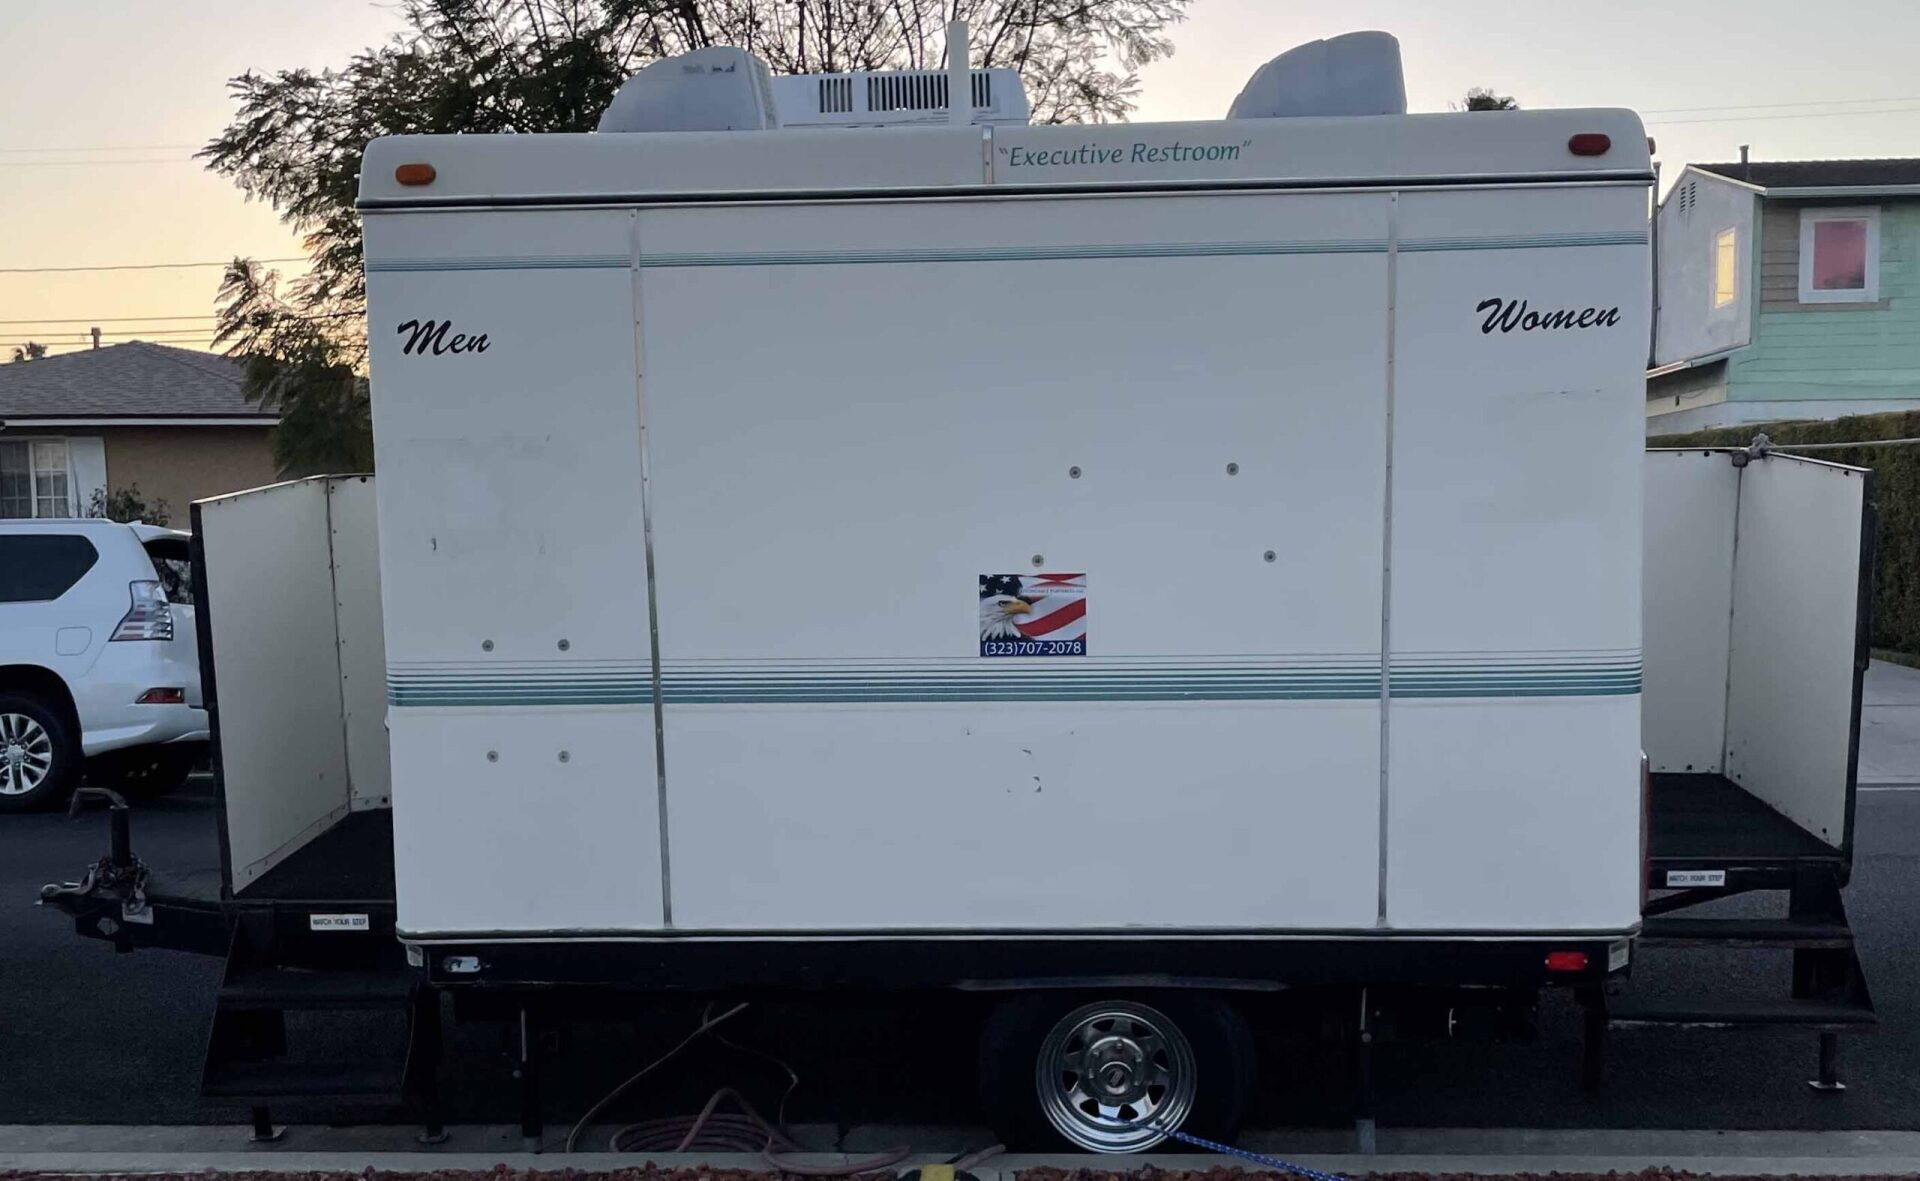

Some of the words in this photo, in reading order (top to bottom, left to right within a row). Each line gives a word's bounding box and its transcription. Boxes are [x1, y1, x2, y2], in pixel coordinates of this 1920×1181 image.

[1476, 297, 1621, 335] Women
[397, 319, 491, 356] Men
[984, 641, 1082, 656] (323)707-2078
[1690, 874, 1706, 882] YOUR
[1708, 874, 1723, 882] STEP
[334, 918, 350, 926] YOUR
[352, 917, 367, 926] STEP
